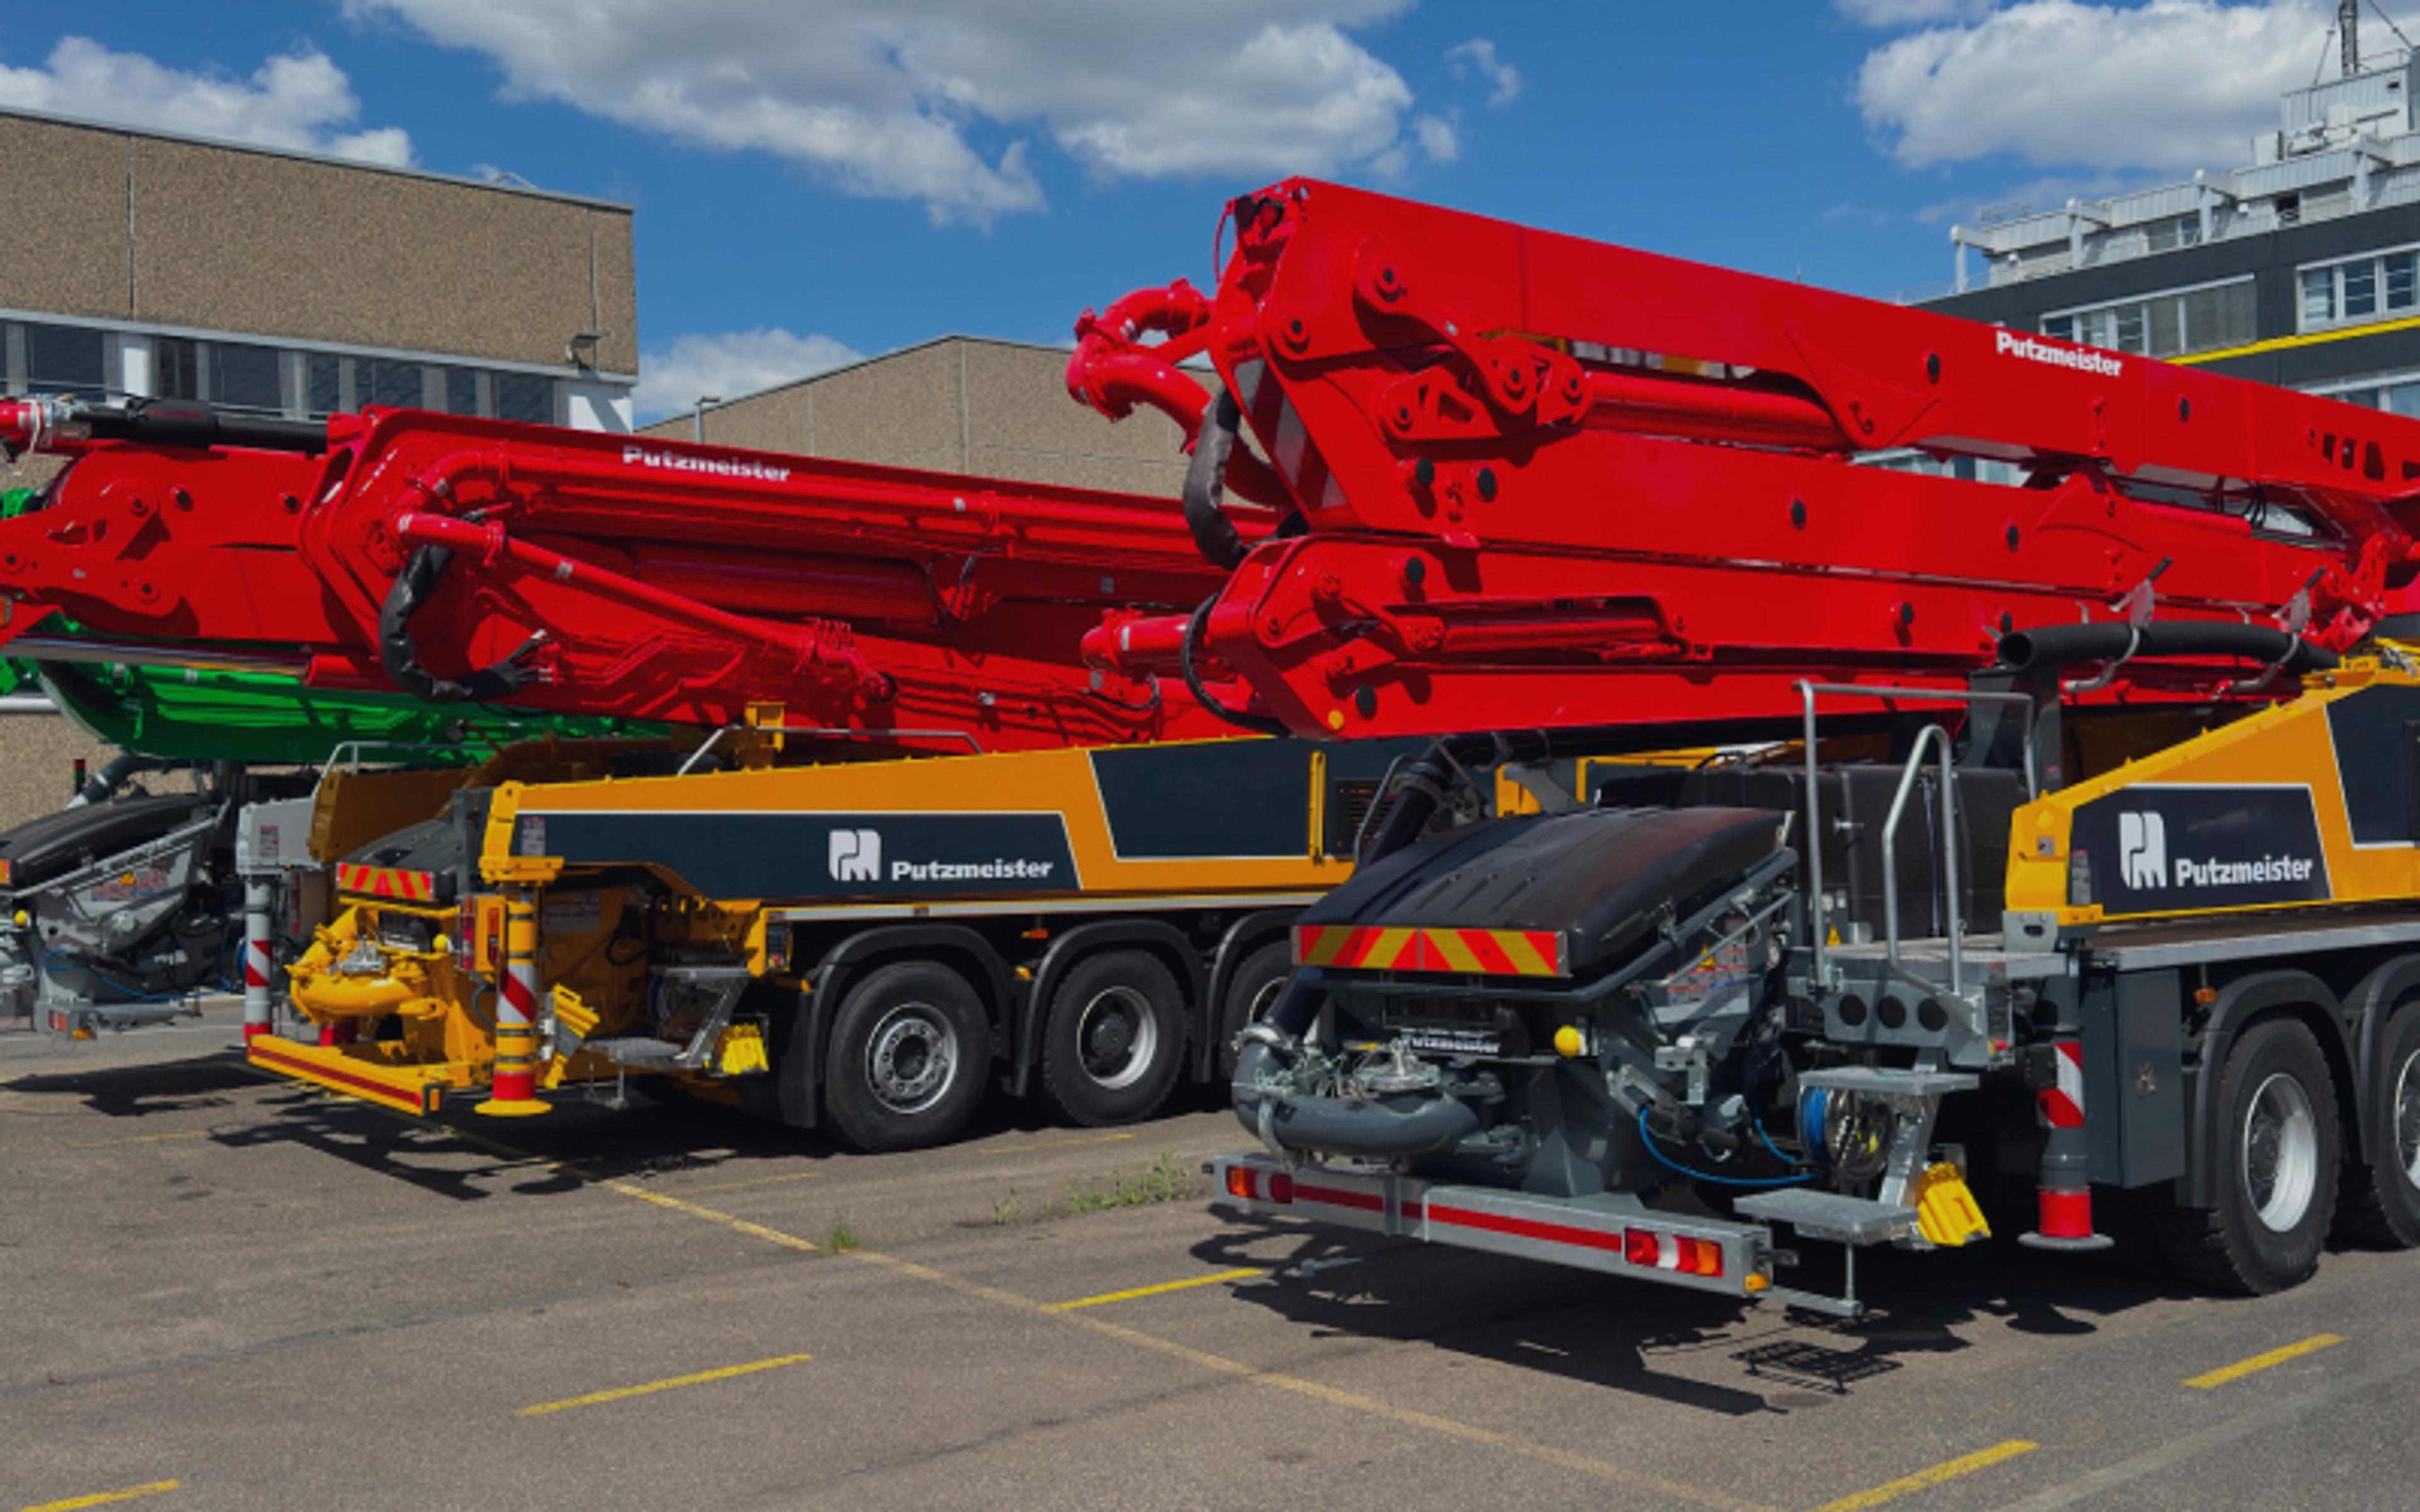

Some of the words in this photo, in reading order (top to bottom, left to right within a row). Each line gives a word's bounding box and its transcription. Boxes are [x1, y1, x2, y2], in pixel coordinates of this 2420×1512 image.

[1996, 329, 2123, 377] Putzmeister
[622, 445, 790, 482] Putzmeister
[892, 859, 1054, 882] Putzmeister
[2175, 852, 2313, 888] Putzmeister
